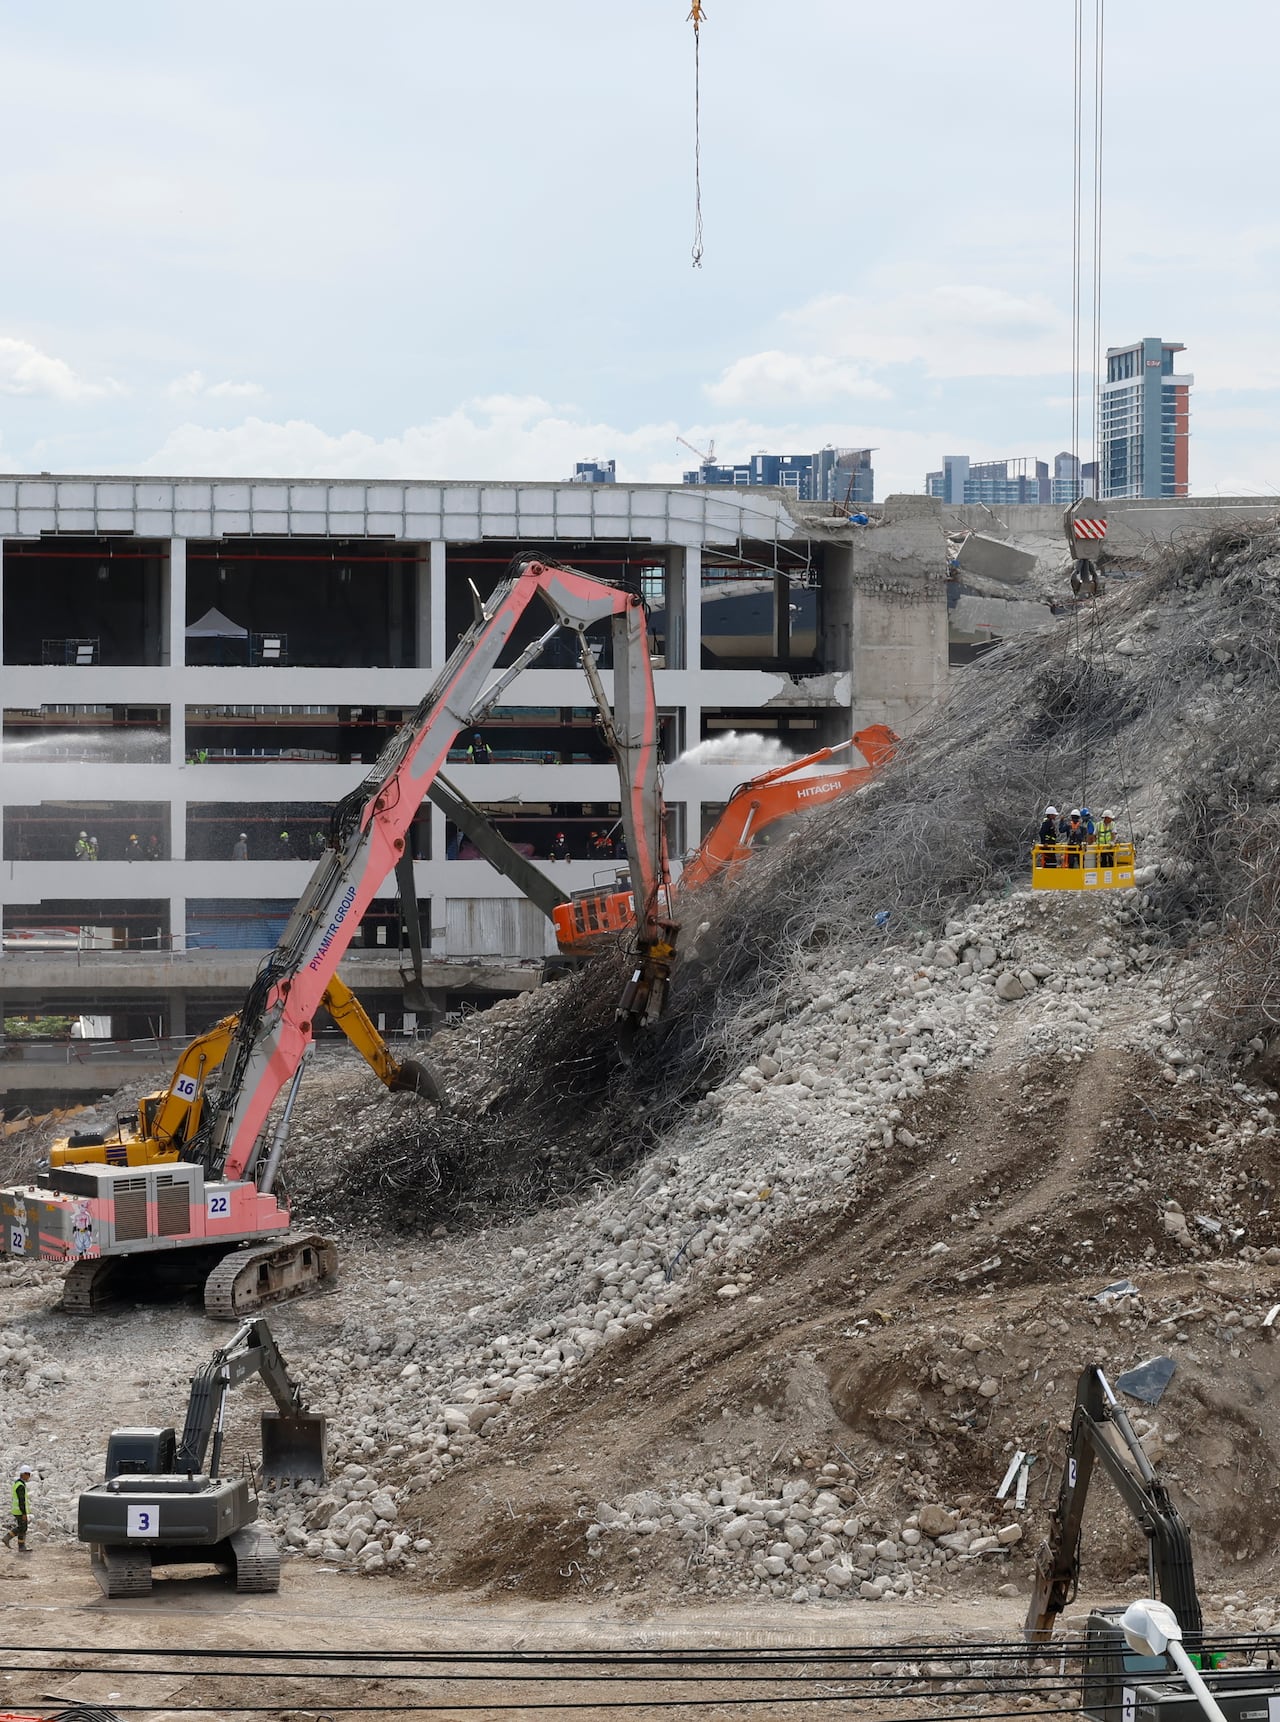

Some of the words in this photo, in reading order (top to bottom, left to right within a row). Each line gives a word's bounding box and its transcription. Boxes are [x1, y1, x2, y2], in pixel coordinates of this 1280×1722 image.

[797, 781, 841, 799] HITACHI
[309, 923, 340, 971] PIYAMITR
[334, 886, 357, 923] GROUP
[177, 1080, 194, 1095] 16
[211, 1198, 227, 1213] 22
[13, 1232, 22, 1248] 22
[1071, 1461, 1076, 1480] 2
[138, 1513, 150, 1531] 3
[1126, 1696, 1131, 1717] 2
